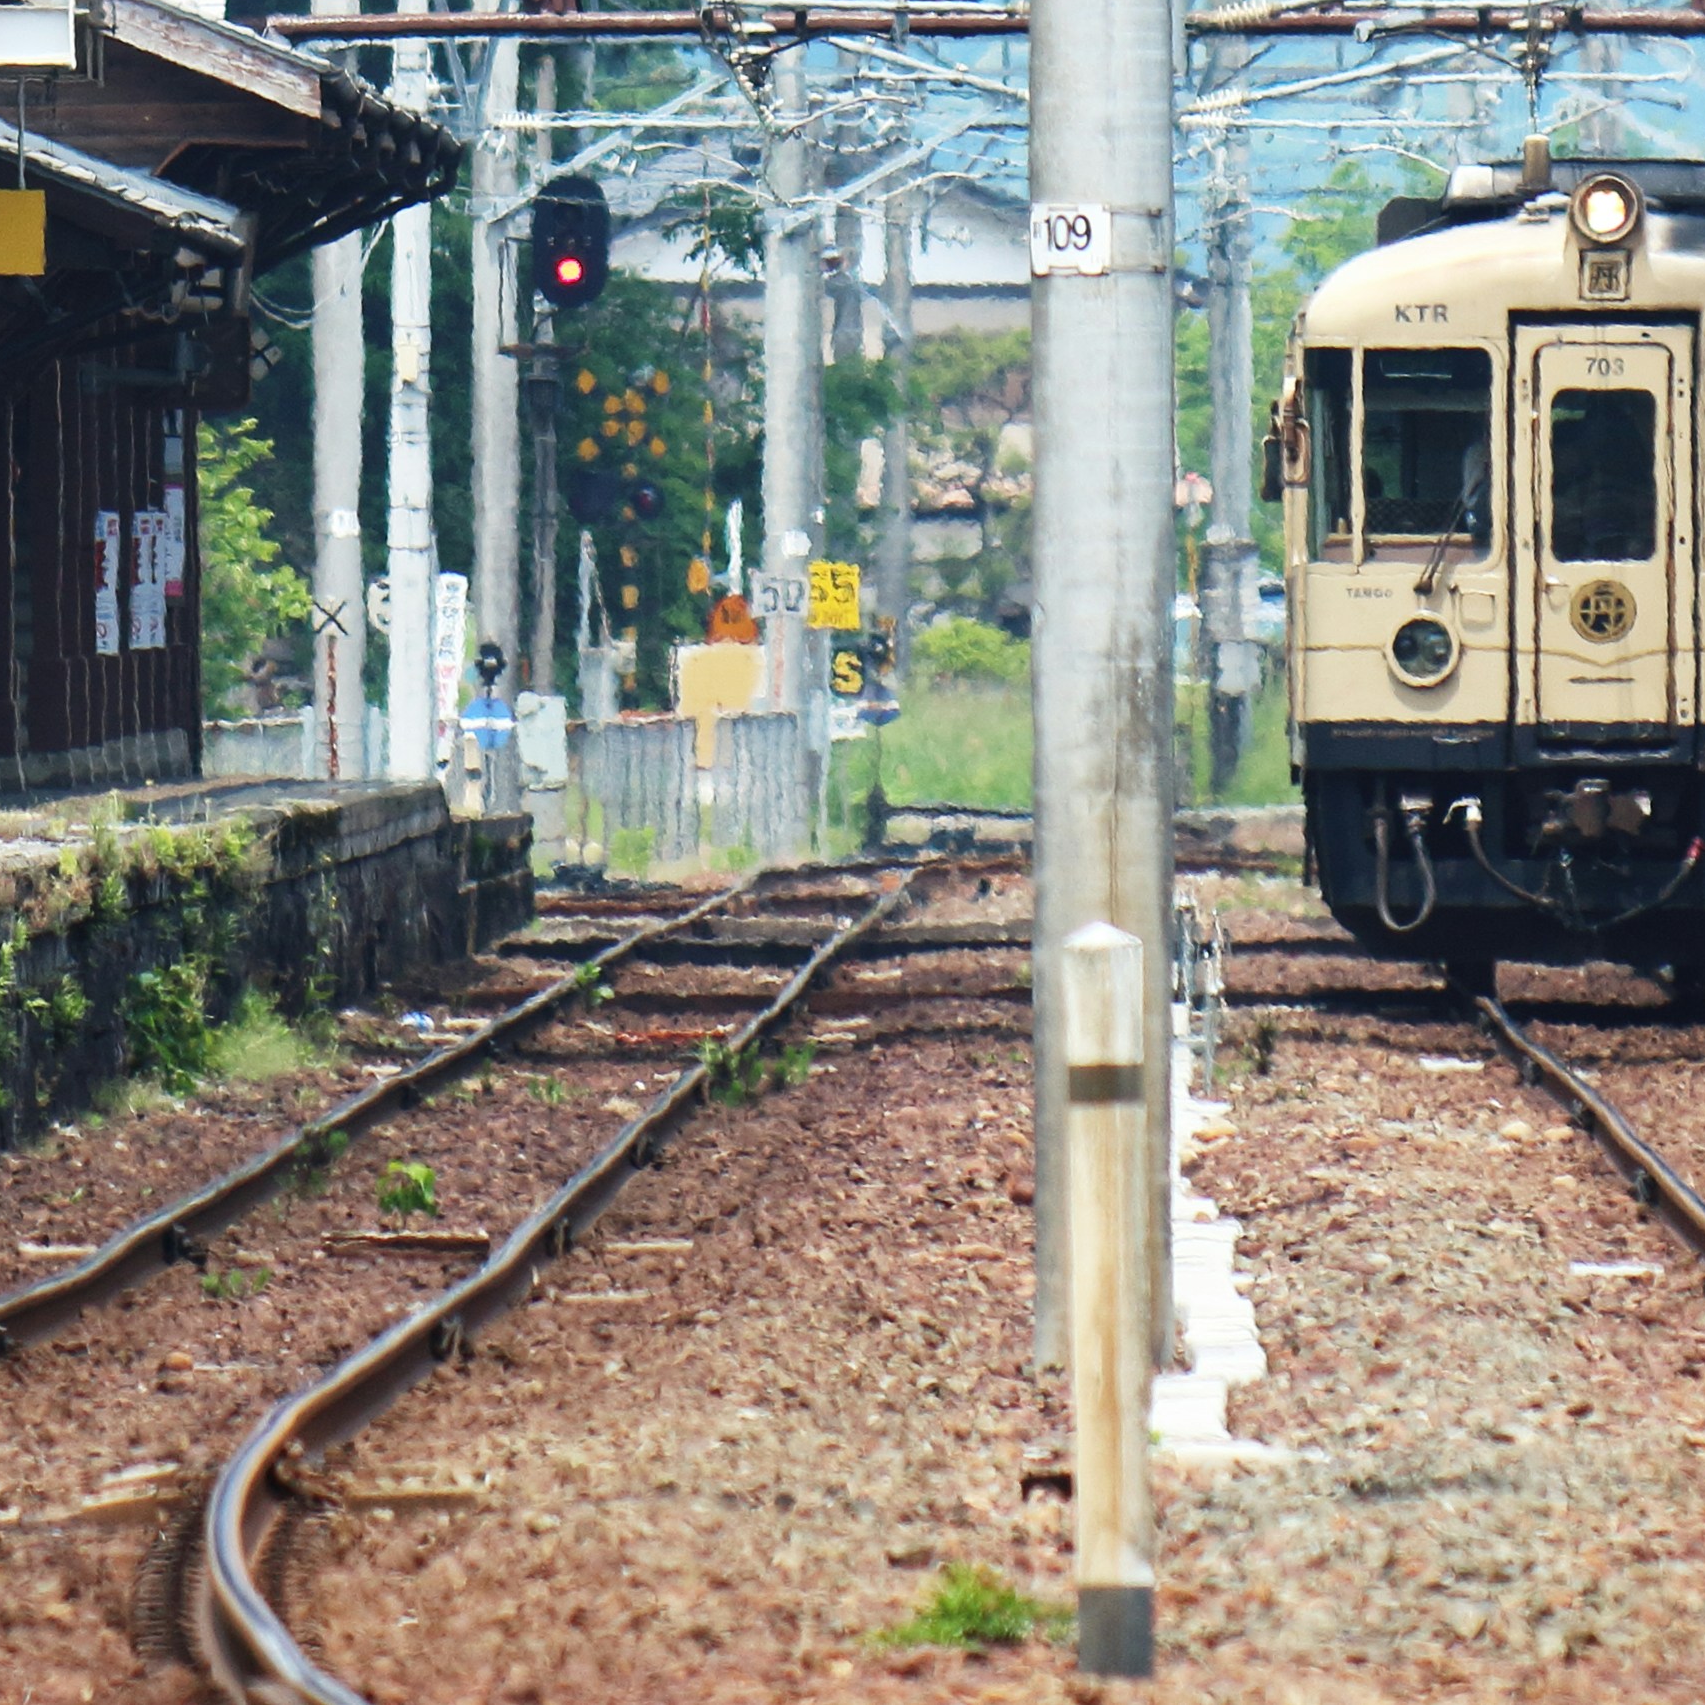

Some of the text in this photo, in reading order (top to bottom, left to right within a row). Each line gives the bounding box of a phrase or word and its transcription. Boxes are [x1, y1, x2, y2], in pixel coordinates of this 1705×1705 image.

[1044, 214, 1092, 252] 109
[1394, 303, 1449, 324] KTR
[1585, 357, 1625, 376] 703
[1345, 587, 1393, 599] TANGO
[831, 650, 864, 694] S
